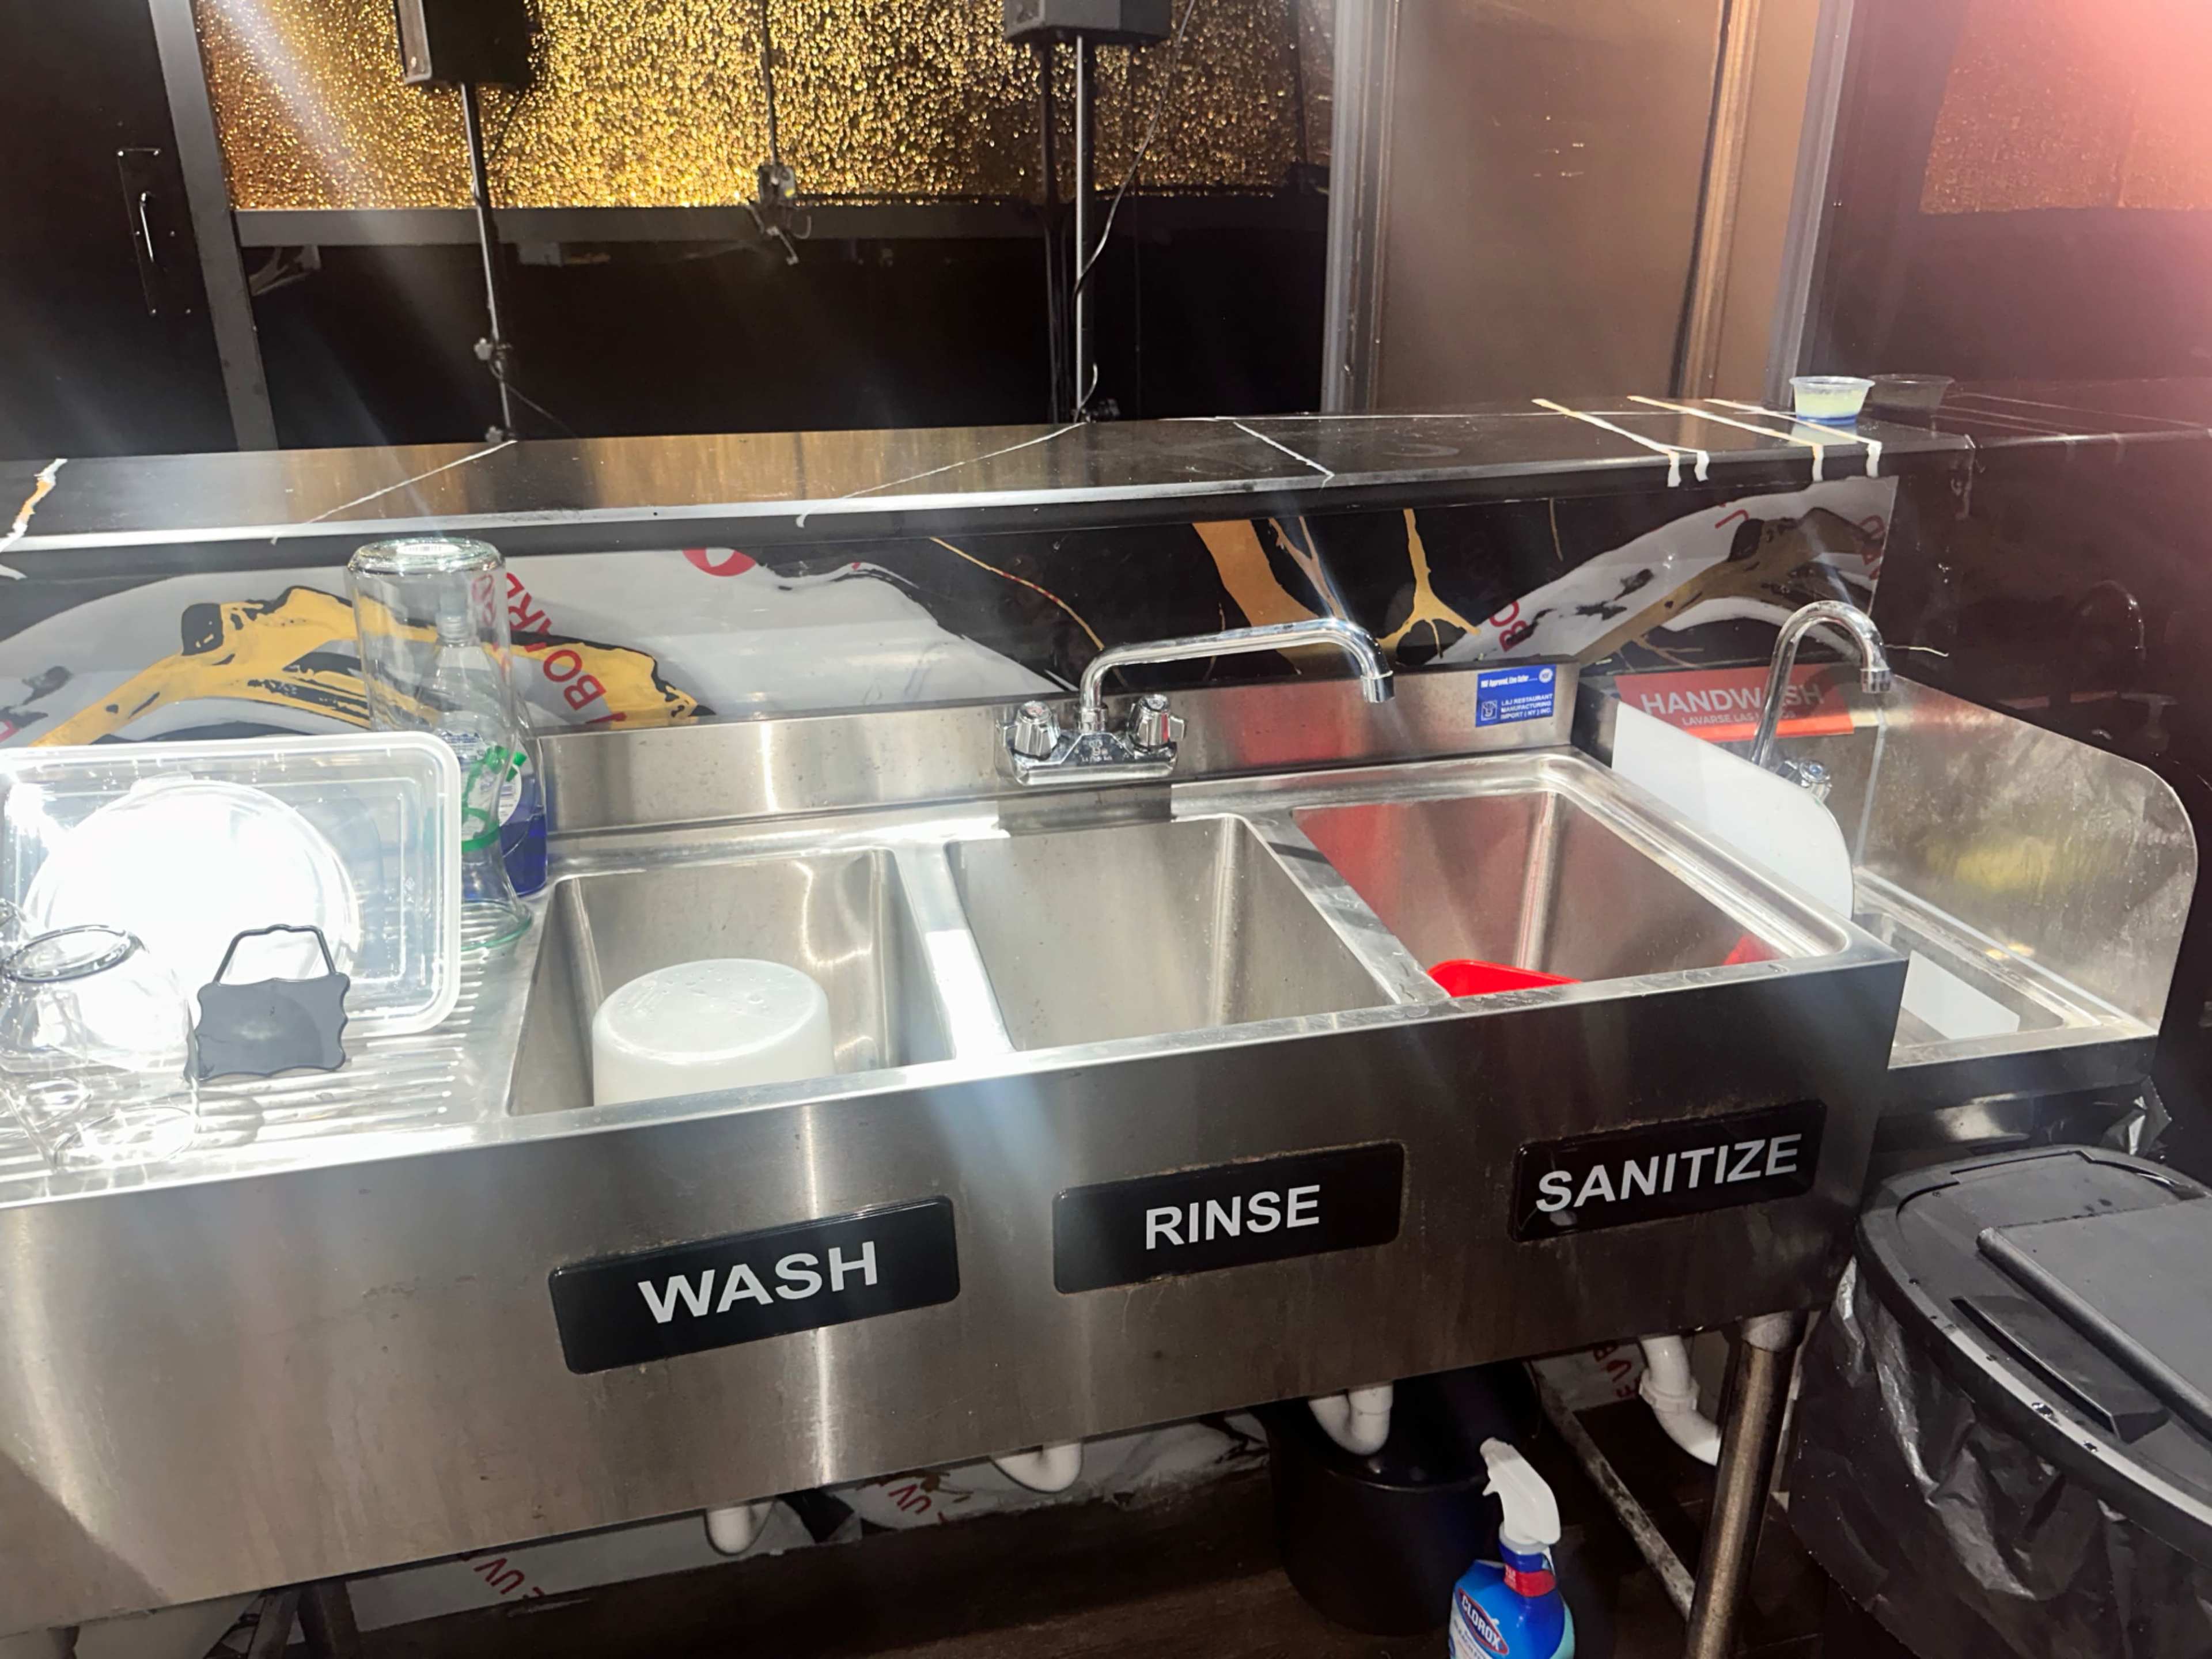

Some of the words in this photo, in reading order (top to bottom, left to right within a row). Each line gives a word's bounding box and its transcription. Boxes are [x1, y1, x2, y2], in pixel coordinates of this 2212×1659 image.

[1501, 700, 1552, 713] MANUFACTURING
[1513, 693, 1553, 704] RESTAURANT
[1641, 684, 1825, 715] HANDWSH
[1500, 711, 1523, 719] IMPORT
[1682, 714, 1731, 726] LAVARSE
[1734, 712, 1755, 723] LAS
[1536, 1133, 1802, 1213] SANITIZE
[1146, 1184, 1320, 1250] RINSE
[638, 1241, 878, 1324] WASH
[1461, 1594, 1501, 1651] CLOROX
